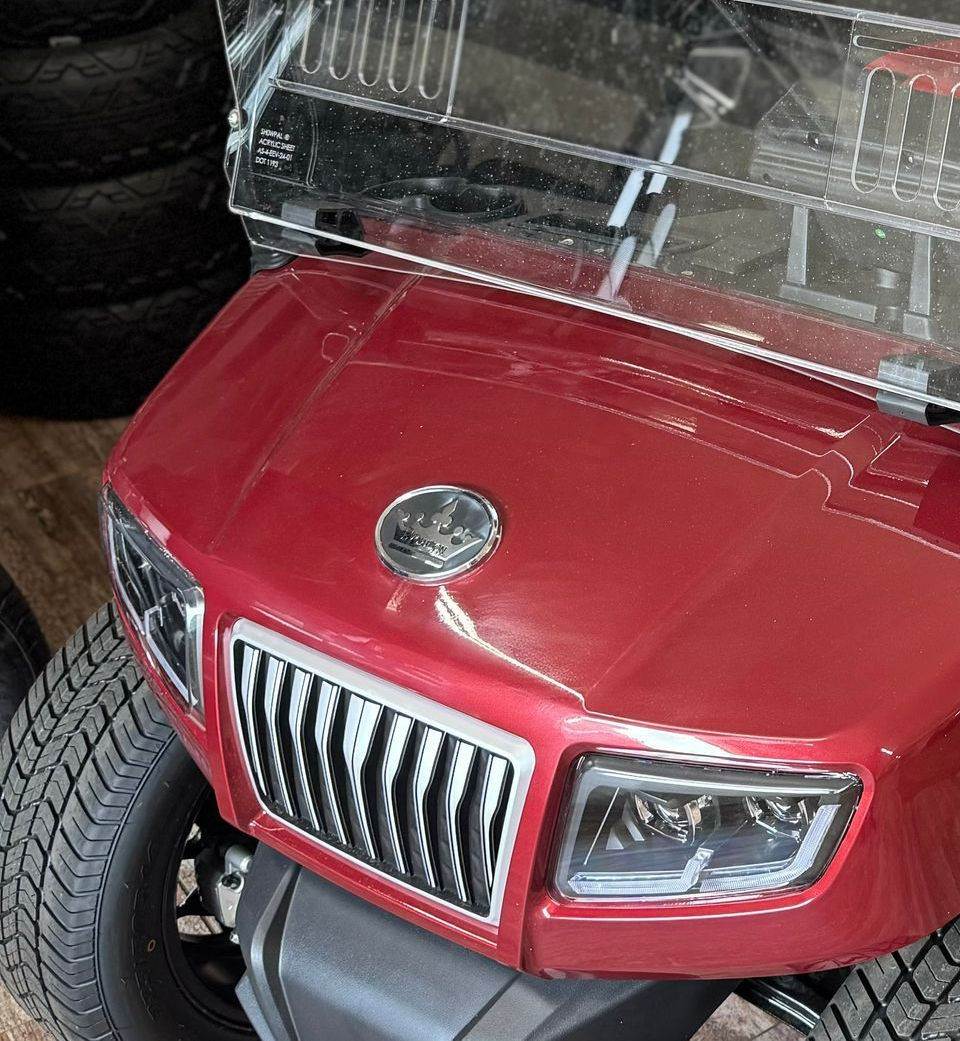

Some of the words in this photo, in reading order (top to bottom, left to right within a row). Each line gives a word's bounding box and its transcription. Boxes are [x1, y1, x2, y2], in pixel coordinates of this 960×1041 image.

[258, 138, 281, 149] ACRYLIC
[280, 142, 296, 152] SHEET
[255, 156, 267, 165] DOT
